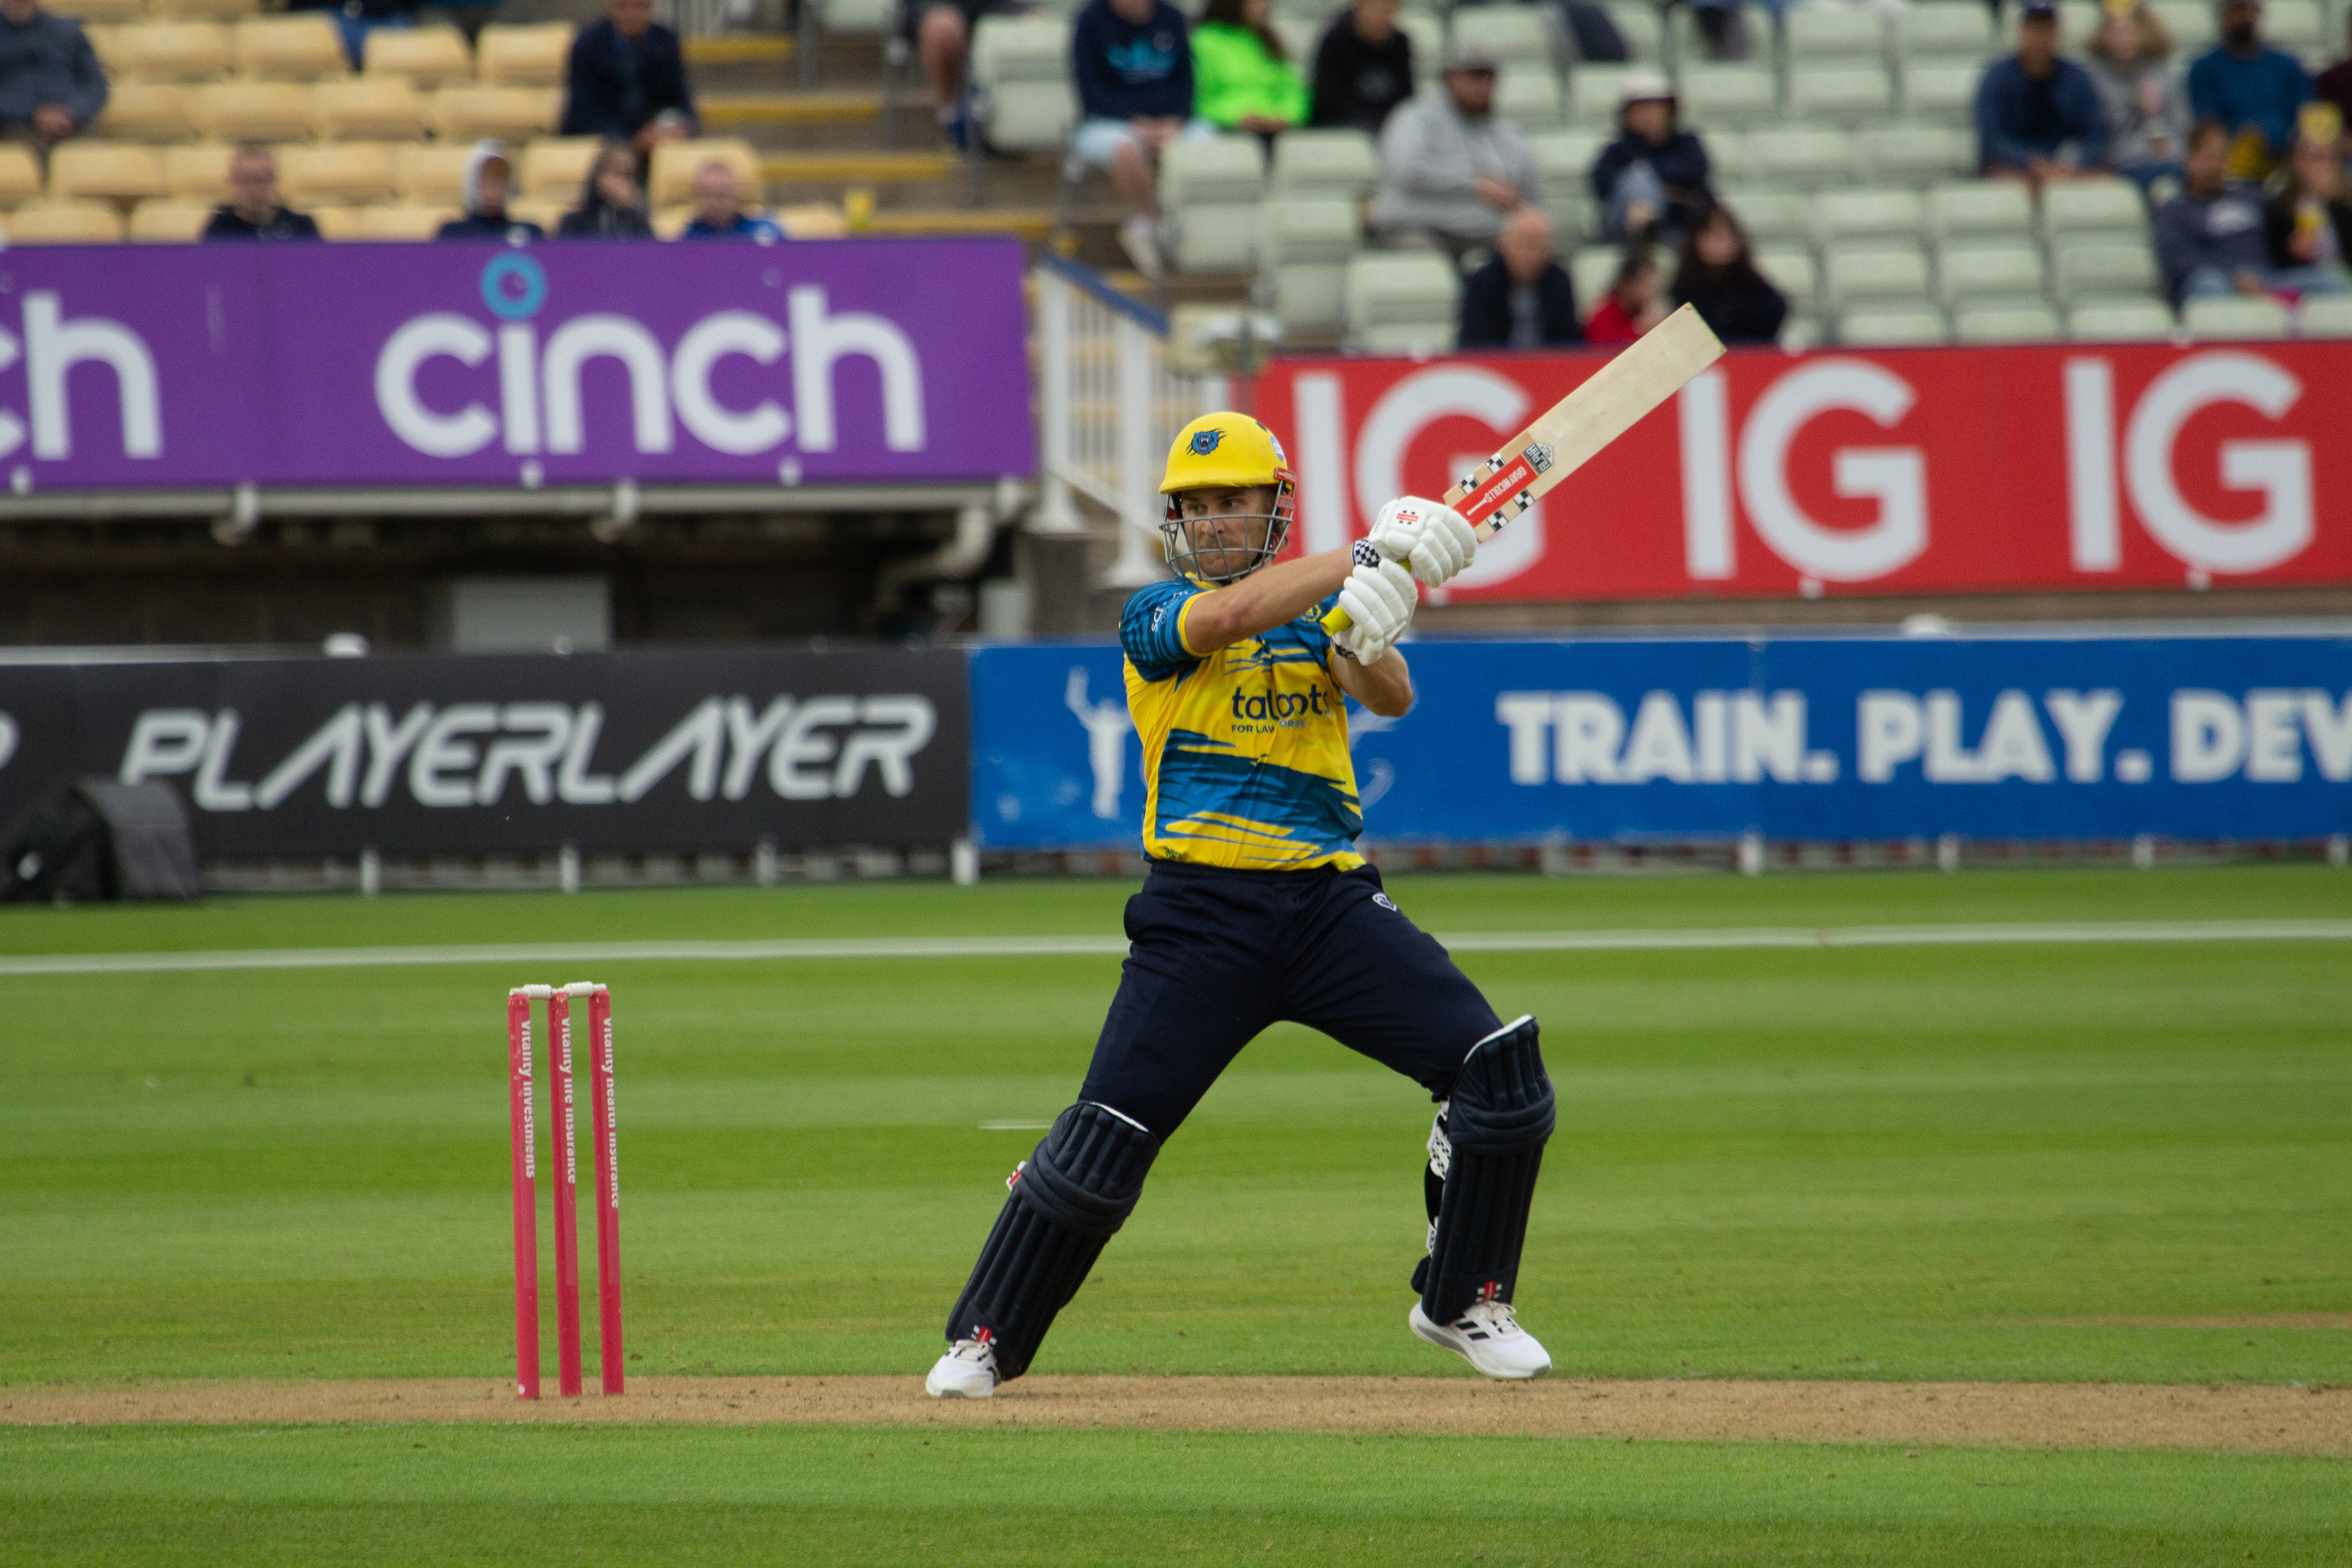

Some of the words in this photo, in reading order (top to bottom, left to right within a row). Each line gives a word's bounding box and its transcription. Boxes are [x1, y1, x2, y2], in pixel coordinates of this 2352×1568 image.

[374, 252, 927, 458] cinch
[1294, 366, 1548, 590] IG
[1677, 356, 1929, 583] IG
[2062, 349, 2316, 575] IG
[122, 692, 938, 811] PLAYERLAYER
[1231, 725, 1253, 733] FOR
[1496, 688, 1838, 786] TRAIN.
[1856, 688, 2153, 784] PLAY.
[522, 1080, 535, 1178] investments
[565, 1107, 576, 1185] insurance
[609, 1132, 619, 1208] insurance
